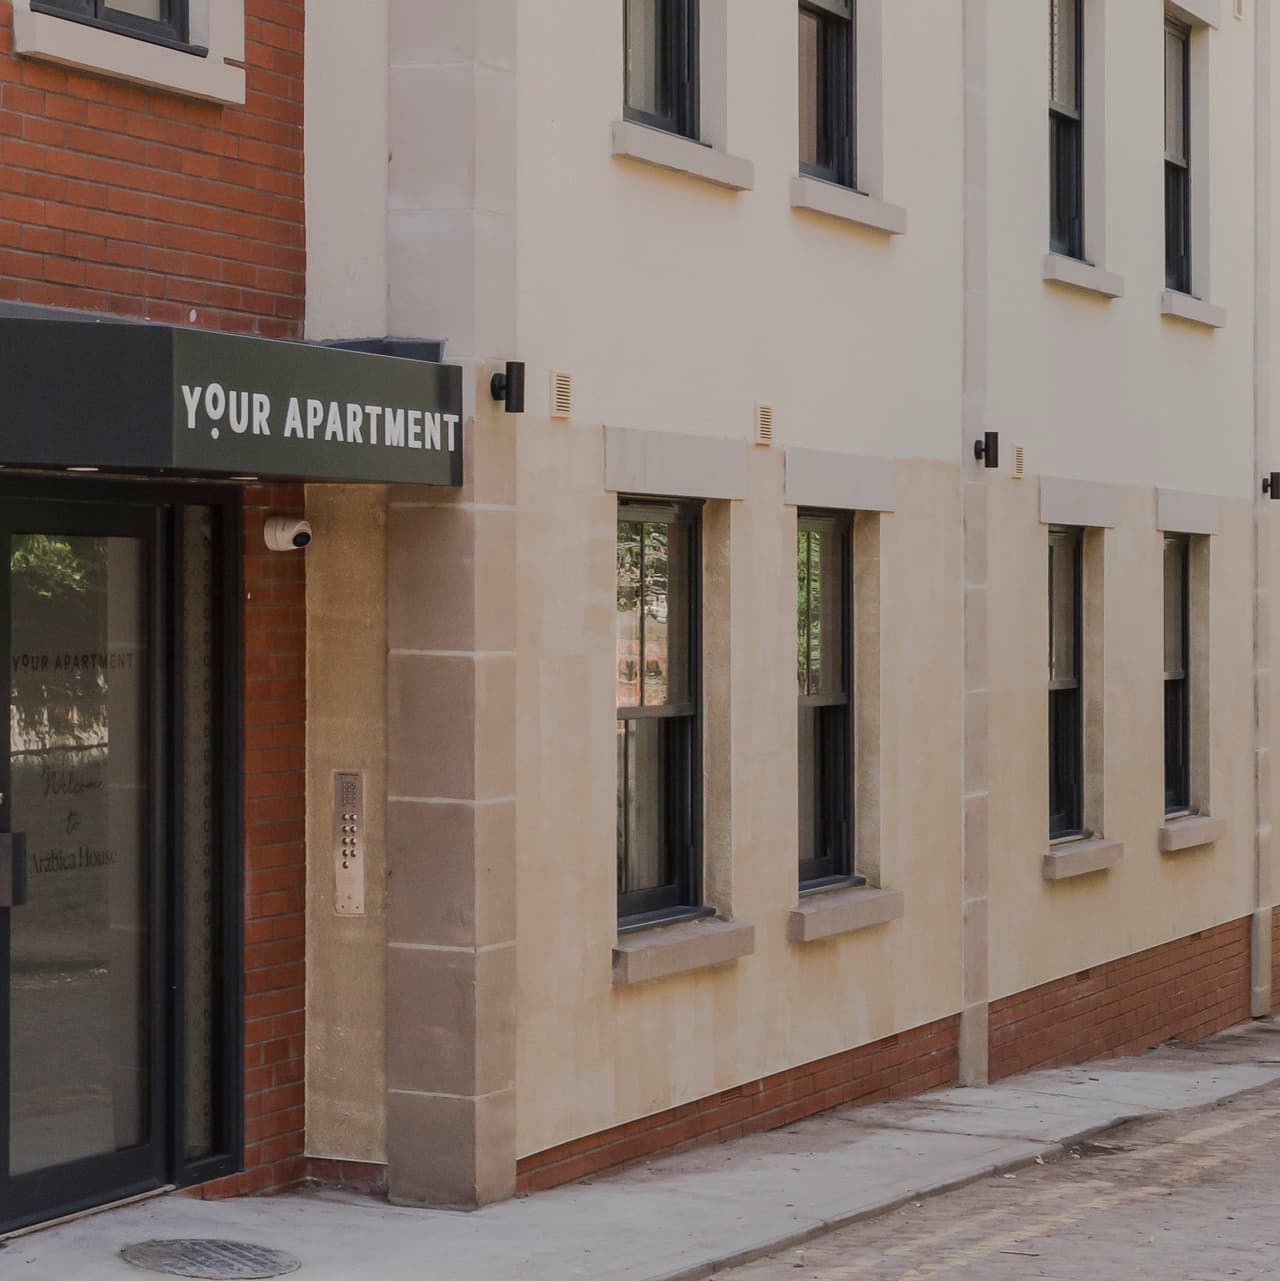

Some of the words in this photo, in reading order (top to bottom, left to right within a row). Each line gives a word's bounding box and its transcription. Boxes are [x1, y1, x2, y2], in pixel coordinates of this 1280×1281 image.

[181, 383, 271, 439] YOUR
[283, 397, 460, 452] APARTMENT
[12, 654, 49, 673] YOUR
[54, 653, 135, 671] APARTMENT
